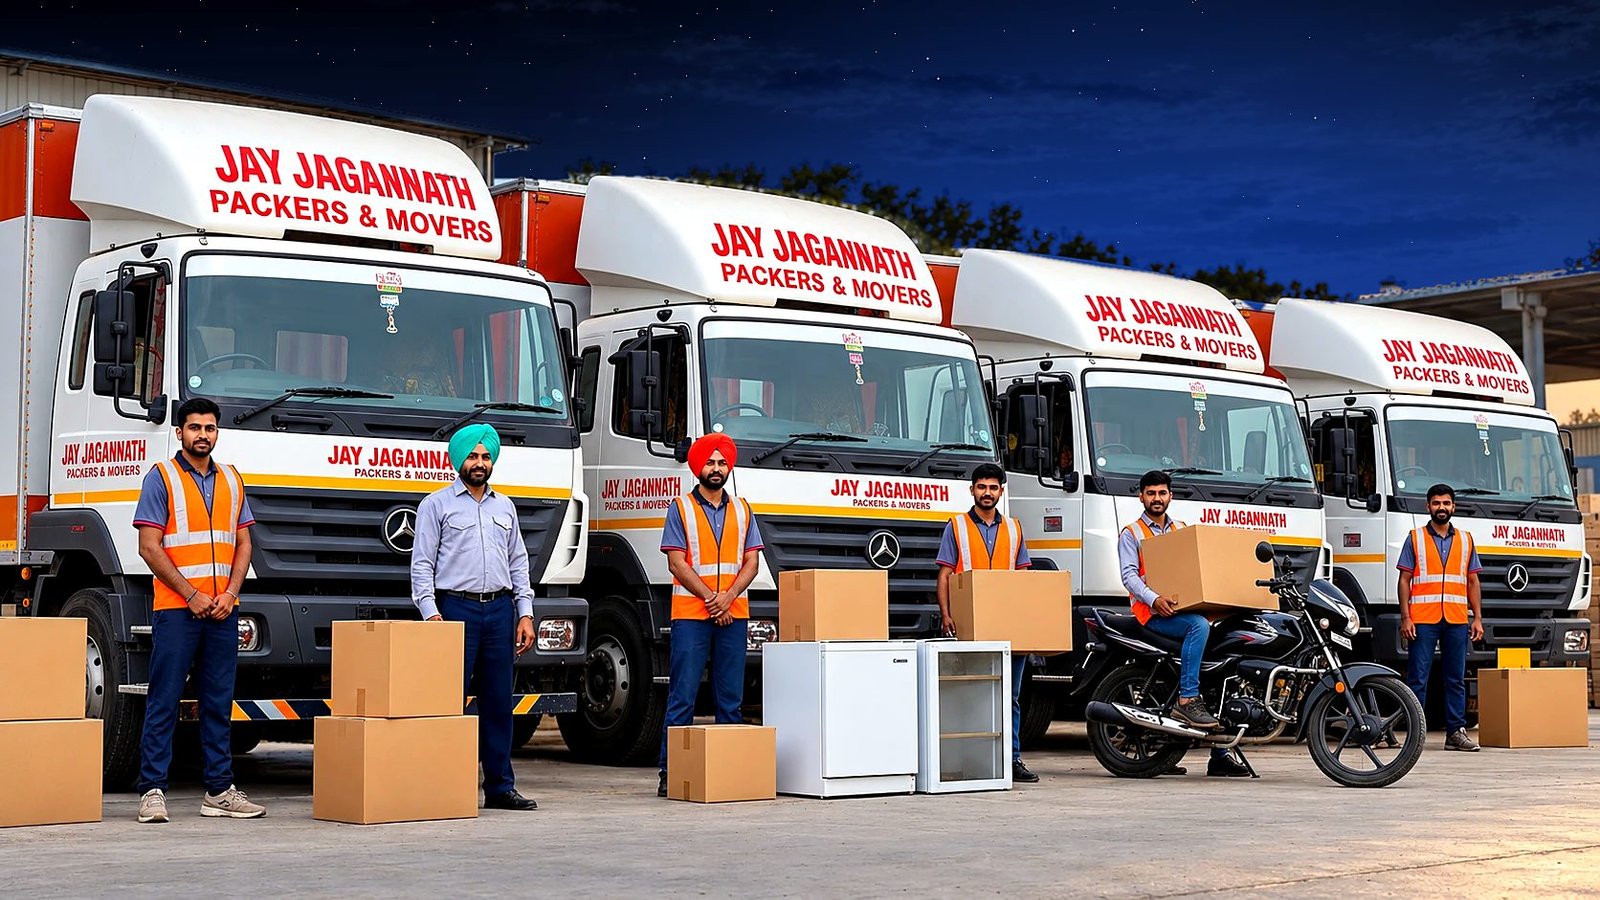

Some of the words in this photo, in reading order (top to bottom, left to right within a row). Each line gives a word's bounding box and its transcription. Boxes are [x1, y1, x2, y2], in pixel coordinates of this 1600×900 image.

[214, 144, 282, 184] JAY
[292, 151, 477, 211] JAGANNATH
[209, 189, 349, 225] PACKERS
[358, 204, 378, 229] &
[385, 207, 493, 244] MOVERS
[710, 222, 765, 259] JAY
[772, 228, 917, 281] JAGANNATH
[720, 262, 825, 293] PACKERS
[832, 275, 847, 296] &
[851, 278, 933, 309] MOVERS
[1084, 294, 1127, 323] JAY
[1129, 297, 1242, 338] JAGANNATH
[1097, 325, 1176, 349] PACKERS
[1180, 334, 1192, 351] &
[1194, 336, 1257, 361] MOVERS
[1381, 338, 1417, 363] JAY
[1419, 341, 1518, 374] JAGANNATH
[1392, 365, 1461, 385] PACKERS
[1464, 372, 1474, 387] &
[1476, 374, 1530, 395] MOVERS
[61, 443, 81, 466] JAY
[81, 439, 147, 465] JAGANNATH
[327, 445, 363, 466] JAY
[368, 447, 455, 471] JAGANNA
[66, 466, 99, 479] PACKERS
[99, 466, 106, 477] &
[107, 464, 141, 477] MOVERS
[354, 468, 402, 479] PACKERS
[404, 470, 412, 479] &
[415, 471, 456, 482] MOVERS
[601, 479, 620, 499] JAY
[621, 476, 681, 498] JAGANNATH
[830, 479, 860, 497] JAY
[863, 480, 950, 502] JAGANNATH
[604, 500, 634, 511] PACKERS
[852, 498, 889, 508] PACKERS
[890, 500, 897, 508] &
[898, 501, 931, 510] MOVERS
[1199, 508, 1221, 524] JAY
[1224, 509, 1287, 528] JAGANNATH
[1491, 525, 1510, 539] JAY
